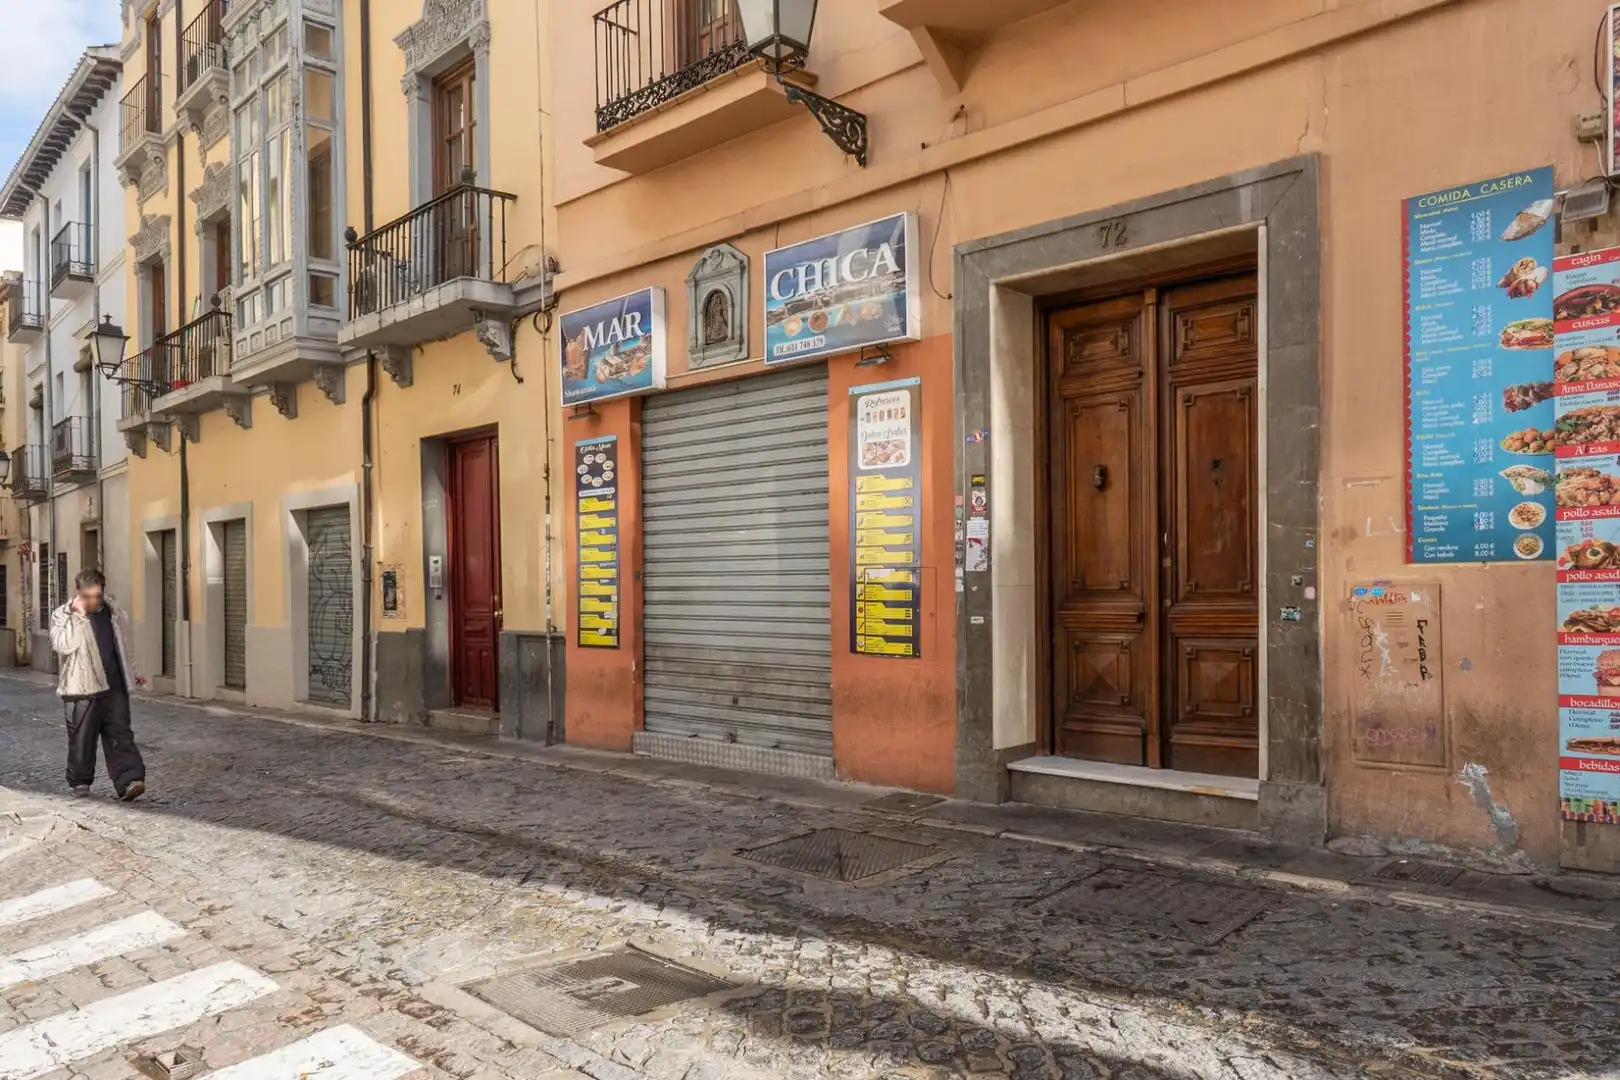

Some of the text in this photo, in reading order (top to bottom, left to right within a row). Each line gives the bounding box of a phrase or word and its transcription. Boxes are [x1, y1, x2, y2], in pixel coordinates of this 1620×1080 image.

[1418, 174, 1533, 208] COMIDA CASERA
[1099, 222, 1128, 248] 72
[770, 242, 901, 301] CHICA
[1572, 317, 1610, 329] cuscus
[582, 311, 646, 351] MAR
[1561, 383, 1585, 394] Arroz
[1575, 445, 1608, 455] Altas
[1563, 508, 1590, 520] pollo
[1566, 570, 1592, 582] pollo
[1564, 634, 1620, 646] hamburgue
[1570, 697, 1620, 708] bocadillos
[1579, 760, 1620, 772] bebidas
